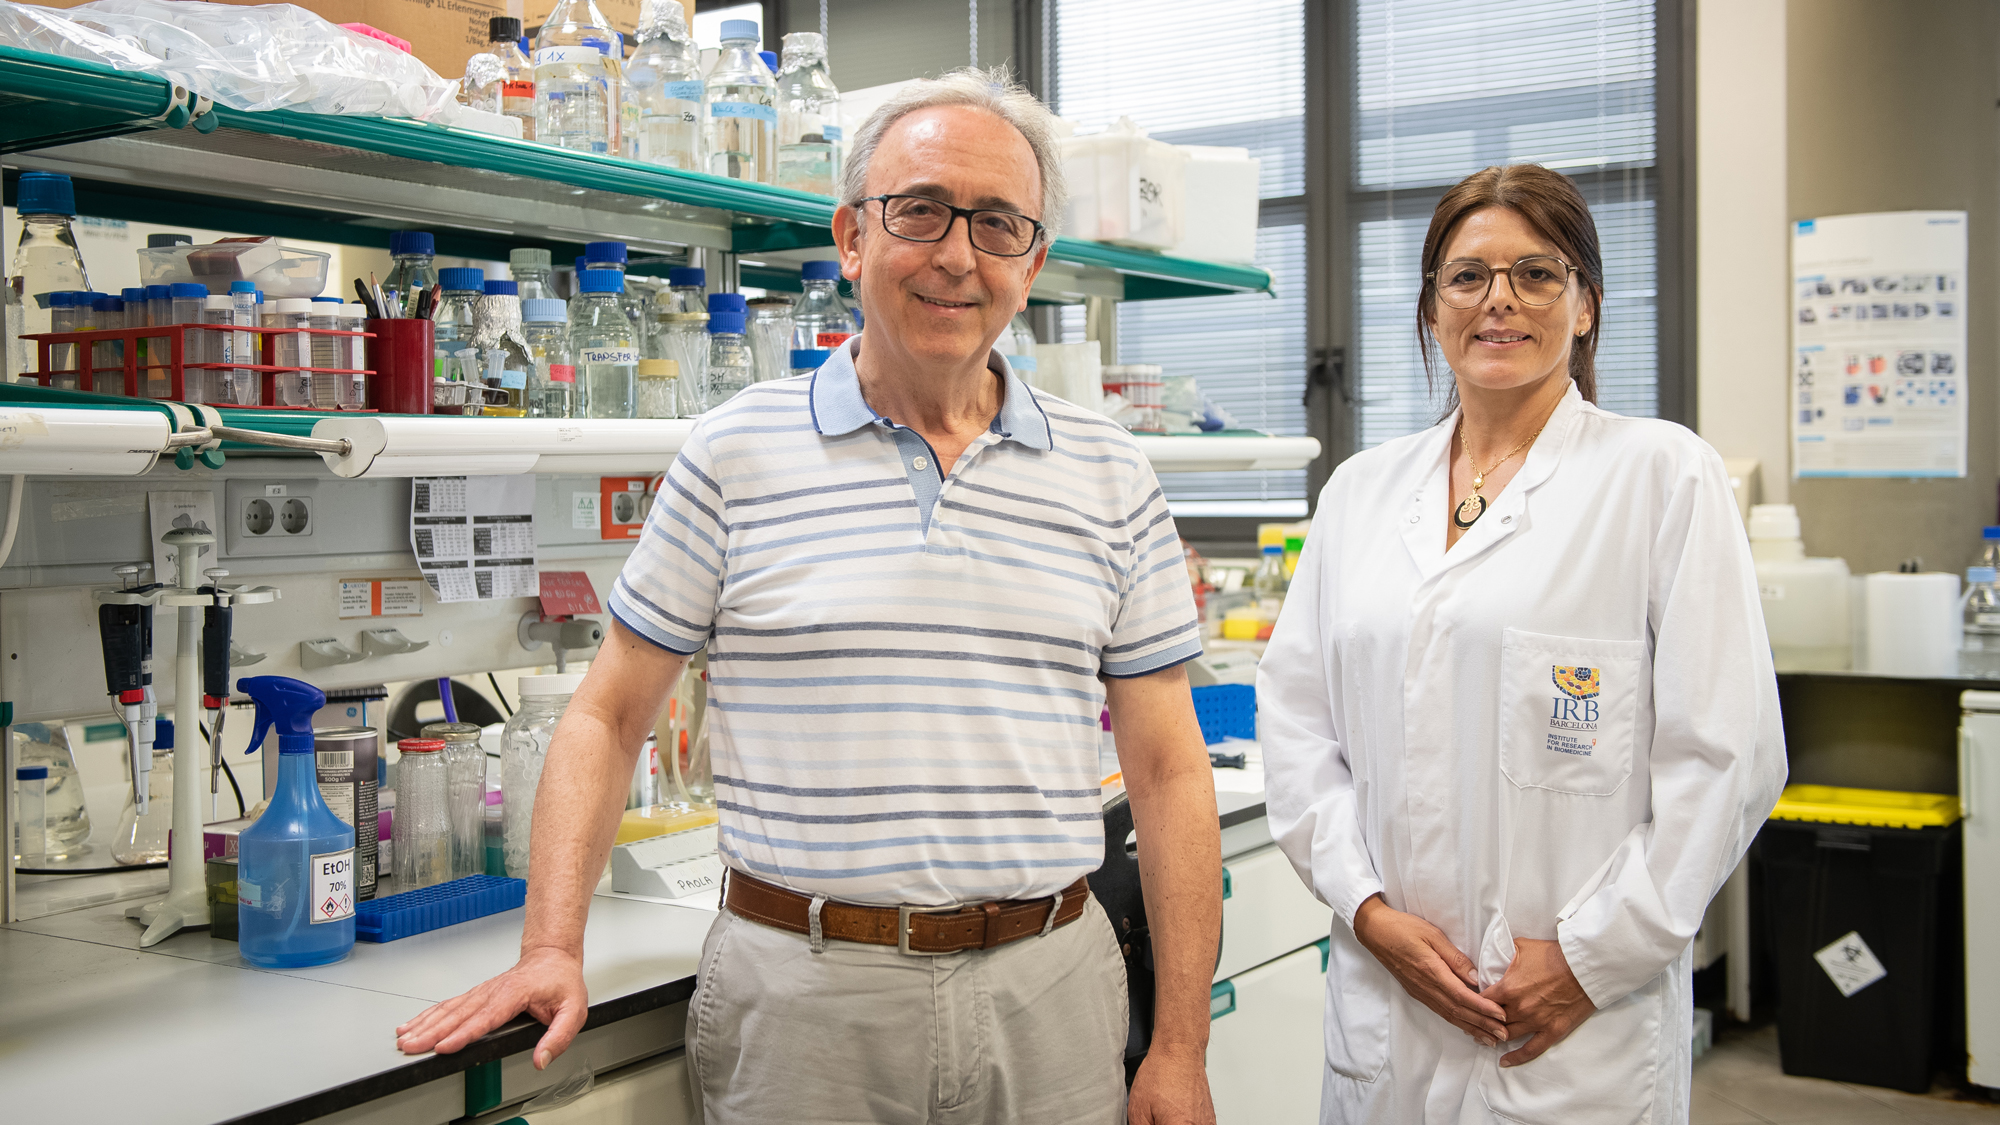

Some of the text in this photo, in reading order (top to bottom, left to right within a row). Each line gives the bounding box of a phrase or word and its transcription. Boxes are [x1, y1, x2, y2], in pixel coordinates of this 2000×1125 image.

[447, 2, 490, 19] Erlenmeyer
[584, 351, 632, 362] TRANSFER
[1551, 697, 1599, 722] IRB
[1550, 719, 1597, 730] BARCELONA
[1548, 733, 1578, 743] INSTITUTE
[1554, 746, 1592, 756] BIOMEDICINE
[1561, 742, 1592, 750] RESEARCH
[323, 859, 350, 875] EtOH
[329, 880, 347, 893] 70%
[677, 876, 713, 890] PAOLA
